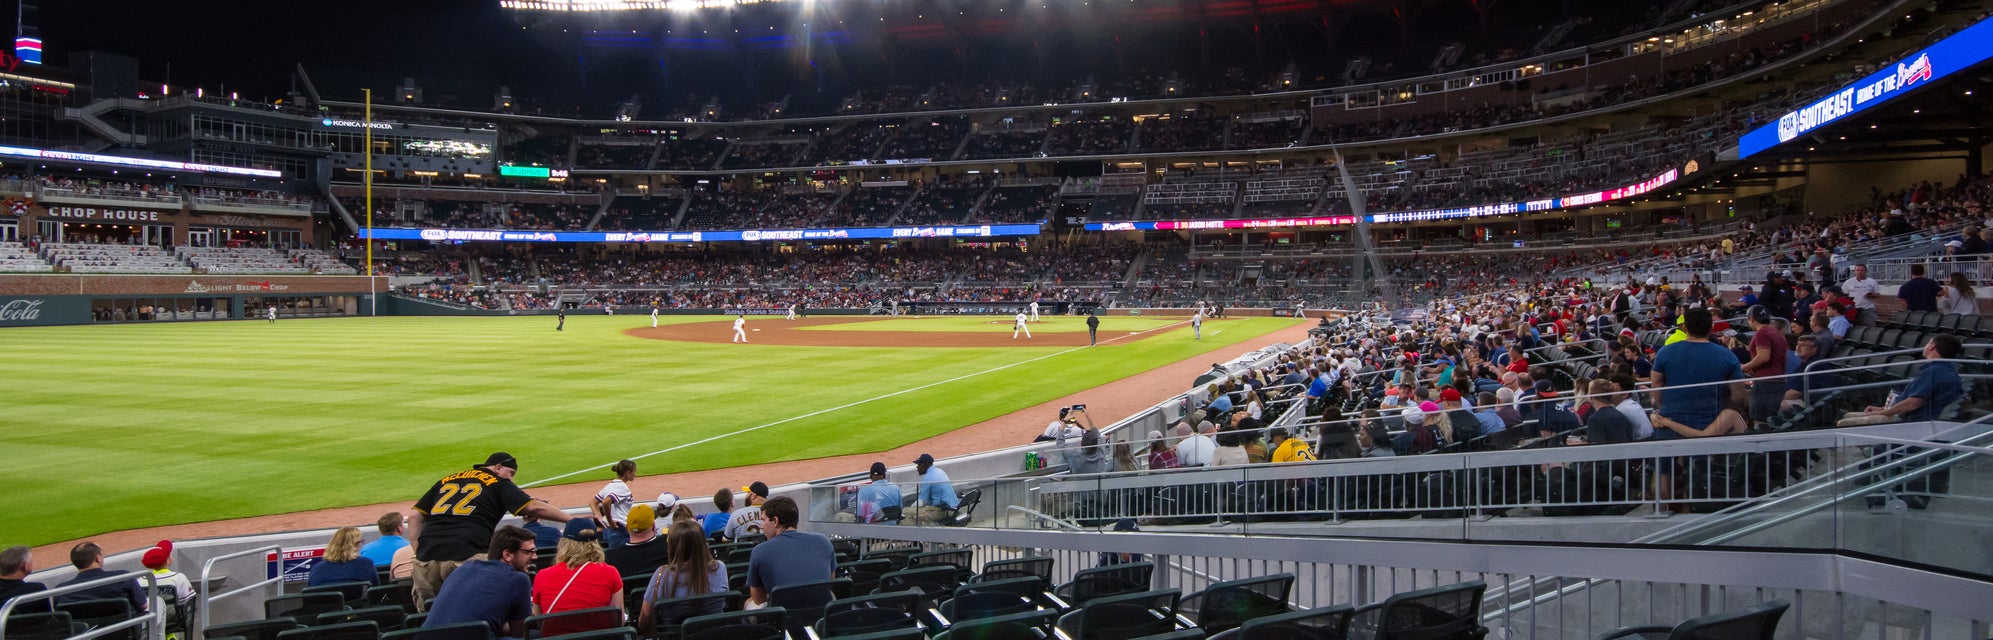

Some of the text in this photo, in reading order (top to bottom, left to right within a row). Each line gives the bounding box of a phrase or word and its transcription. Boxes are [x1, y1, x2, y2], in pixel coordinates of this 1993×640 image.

[1799, 52, 1927, 133] SOUTHEAST HOME OF THE Braves
[333, 120, 361, 128] KONICA
[48, 206, 158, 221] CHOP HOUSE
[1189, 221, 1205, 229] JASON
[1205, 220, 1224, 229] MOTTE
[448, 230, 503, 240] SOUTHEAST
[605, 233, 626, 241] EVERY
[761, 230, 804, 240] SOUTHEAST
[893, 227, 913, 237] EVERY
[430, 483, 483, 516] 22
[736, 511, 763, 526] CLEM
[293, 550, 315, 559] ALERT
